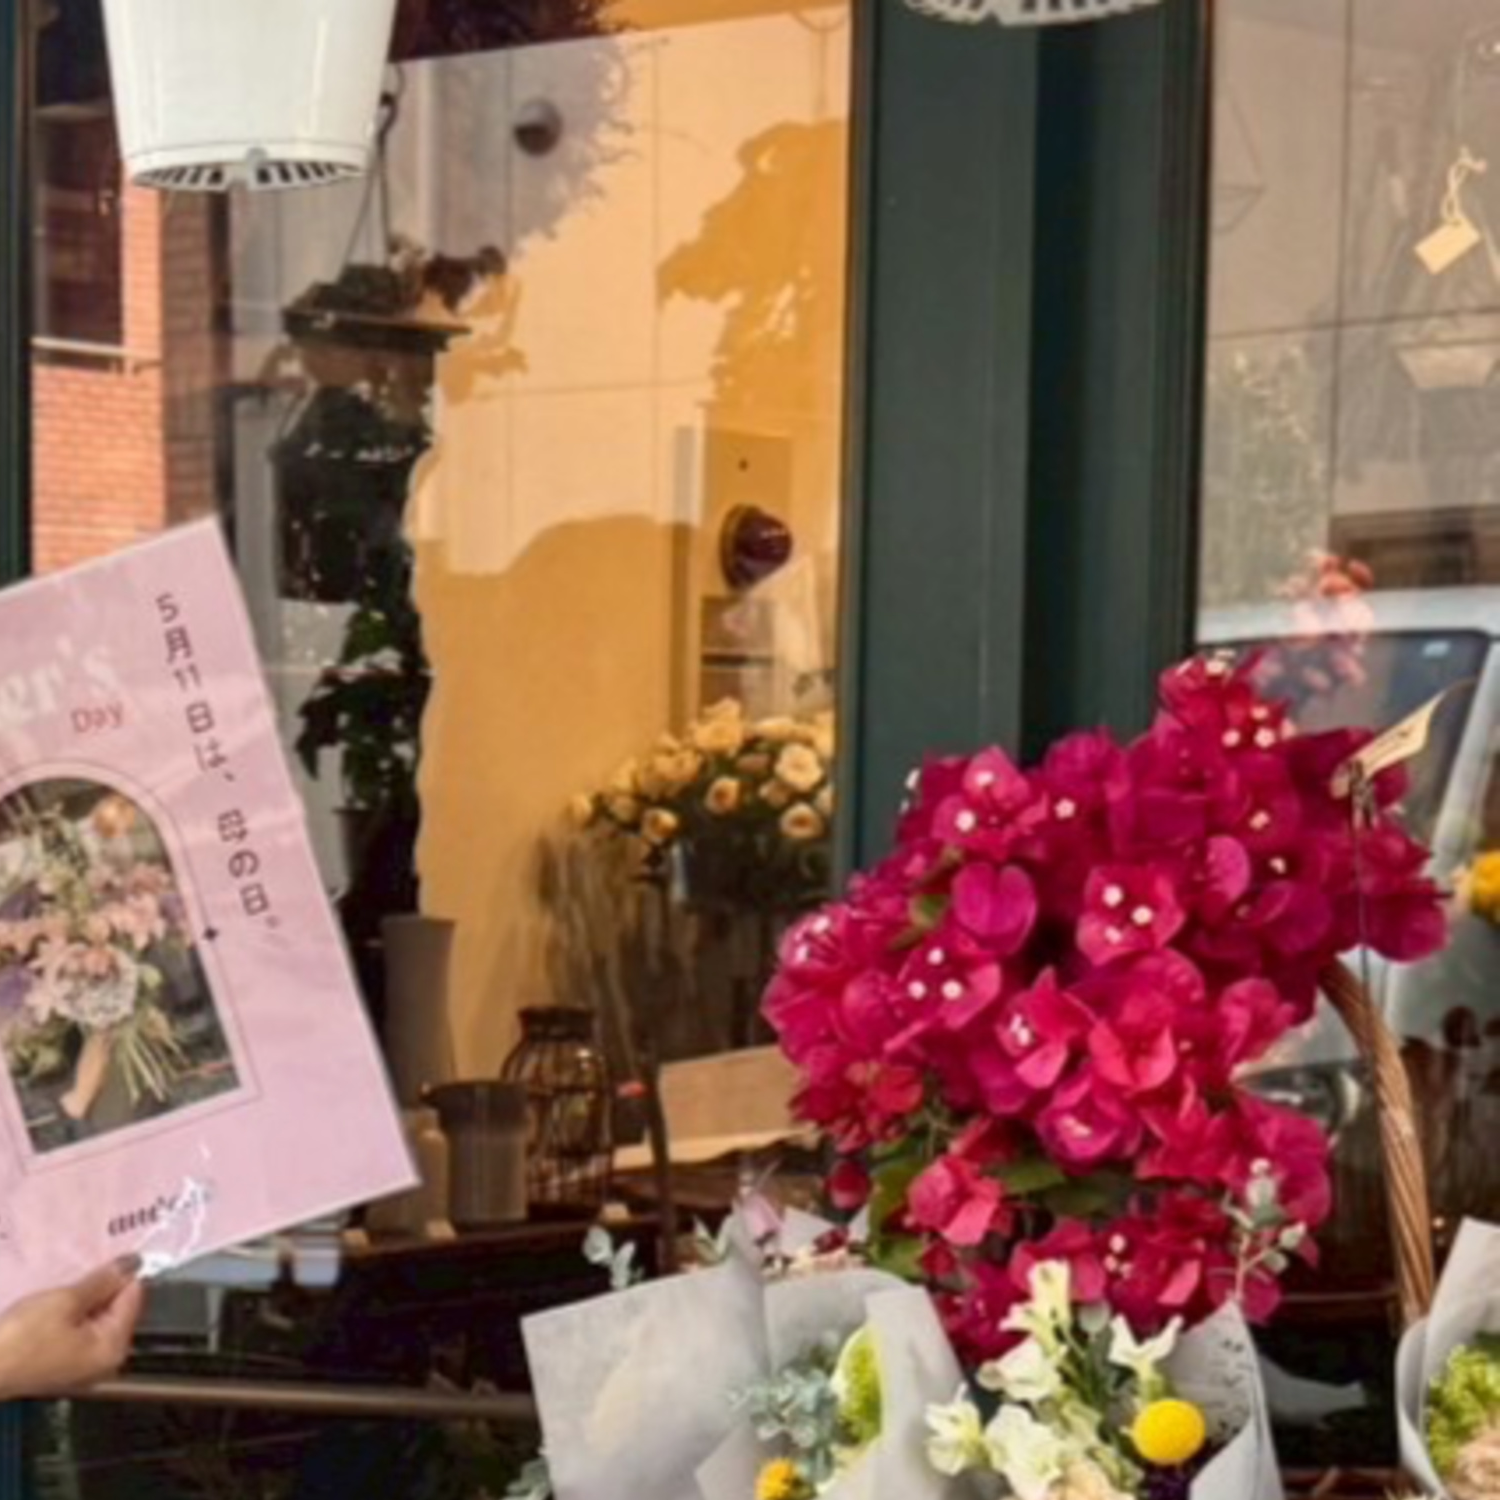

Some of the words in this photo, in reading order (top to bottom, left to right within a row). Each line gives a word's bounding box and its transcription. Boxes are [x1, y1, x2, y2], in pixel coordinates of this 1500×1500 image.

[70, 702, 124, 735] Day
[156, 592, 279, 929] 5月11日は、母の日。
